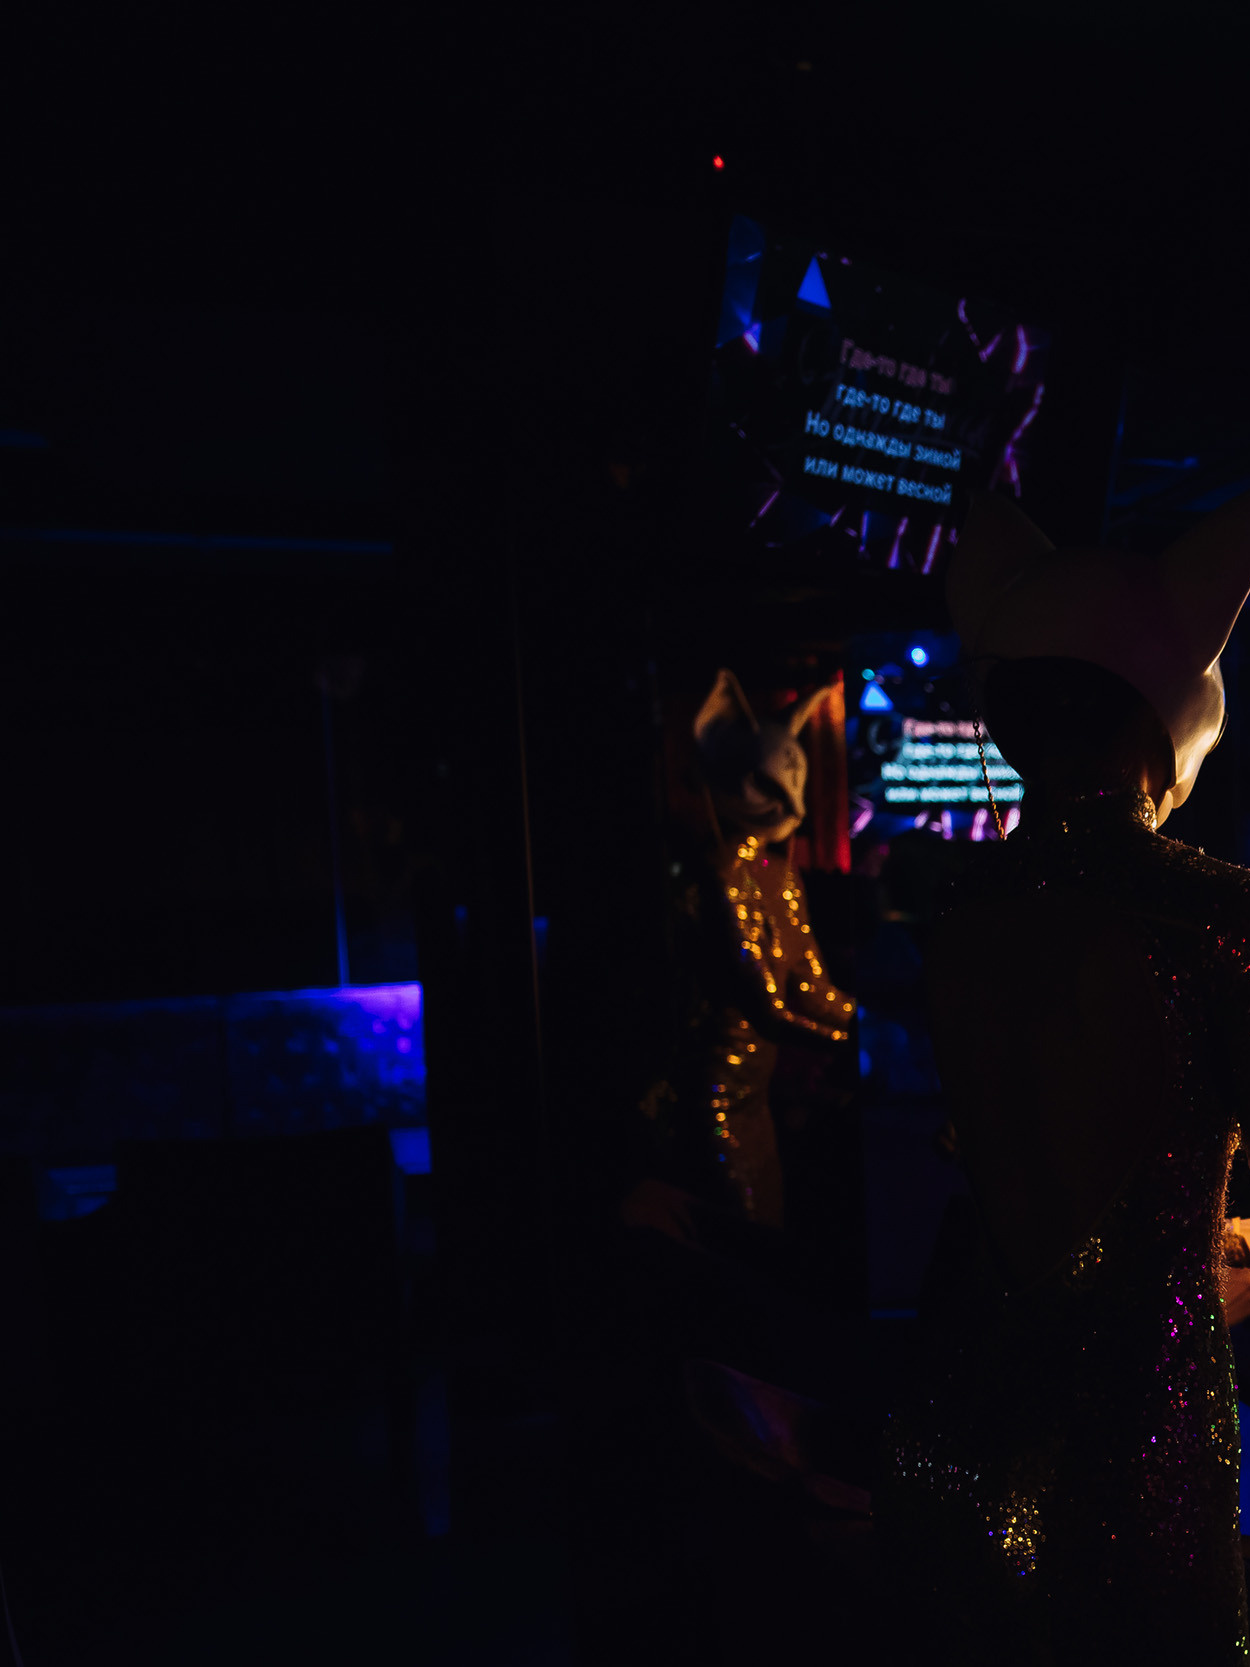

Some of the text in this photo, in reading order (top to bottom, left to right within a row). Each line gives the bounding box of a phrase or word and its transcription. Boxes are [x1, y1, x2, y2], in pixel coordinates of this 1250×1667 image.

[836, 383, 947, 431] где-то где ты
[804, 409, 962, 473] Но однажды зимой
[803, 455, 952, 506] или может весной
